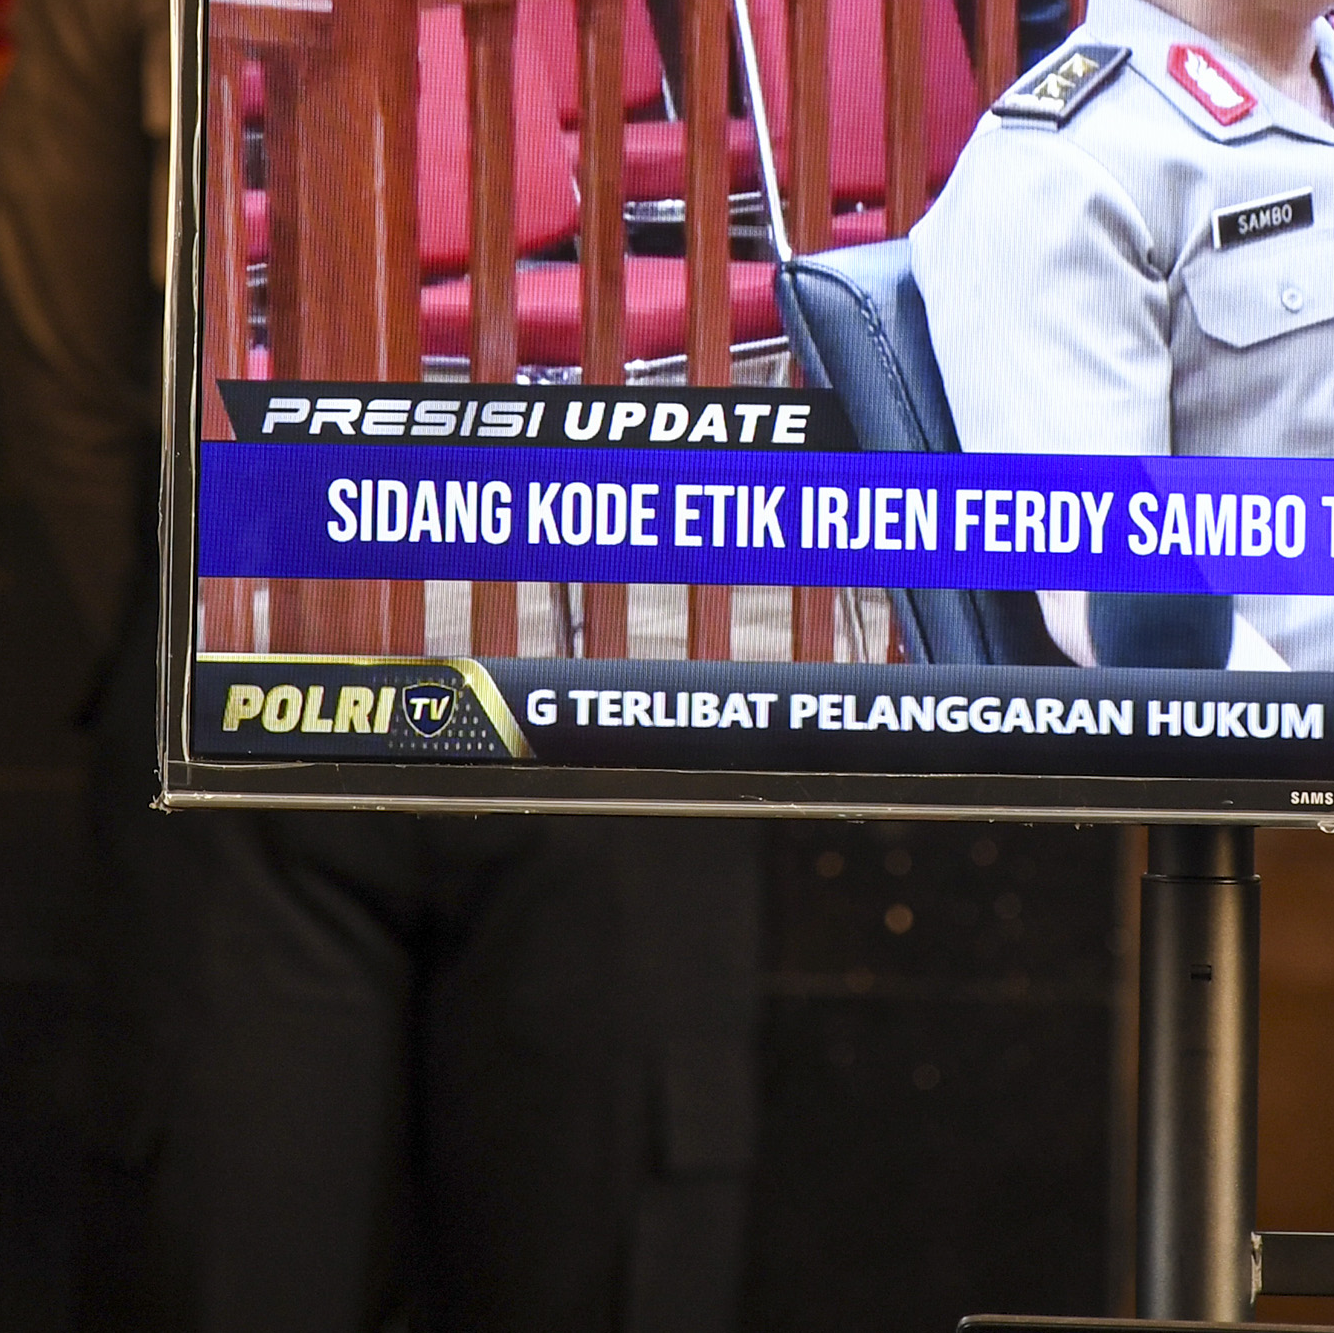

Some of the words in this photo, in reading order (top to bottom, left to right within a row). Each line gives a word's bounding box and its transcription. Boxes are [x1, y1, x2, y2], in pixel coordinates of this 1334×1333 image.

[1238, 204, 1292, 235] SAMBO
[261, 398, 546, 438] PRESISI
[564, 401, 811, 444] UPDATE
[327, 478, 512, 544] SIDANG
[527, 481, 660, 547] KODE
[674, 484, 786, 549] ETIK
[801, 486, 938, 551] IRJEN
[954, 489, 1114, 554] FERDY
[1127, 491, 1307, 559] SAMBO
[222, 684, 397, 734] POLRI
[409, 695, 451, 721] TV
[568, 689, 779, 730] TERLIBAT
[790, 693, 1134, 737] PELANGGARAN
[1148, 700, 1324, 740] HUKUM
